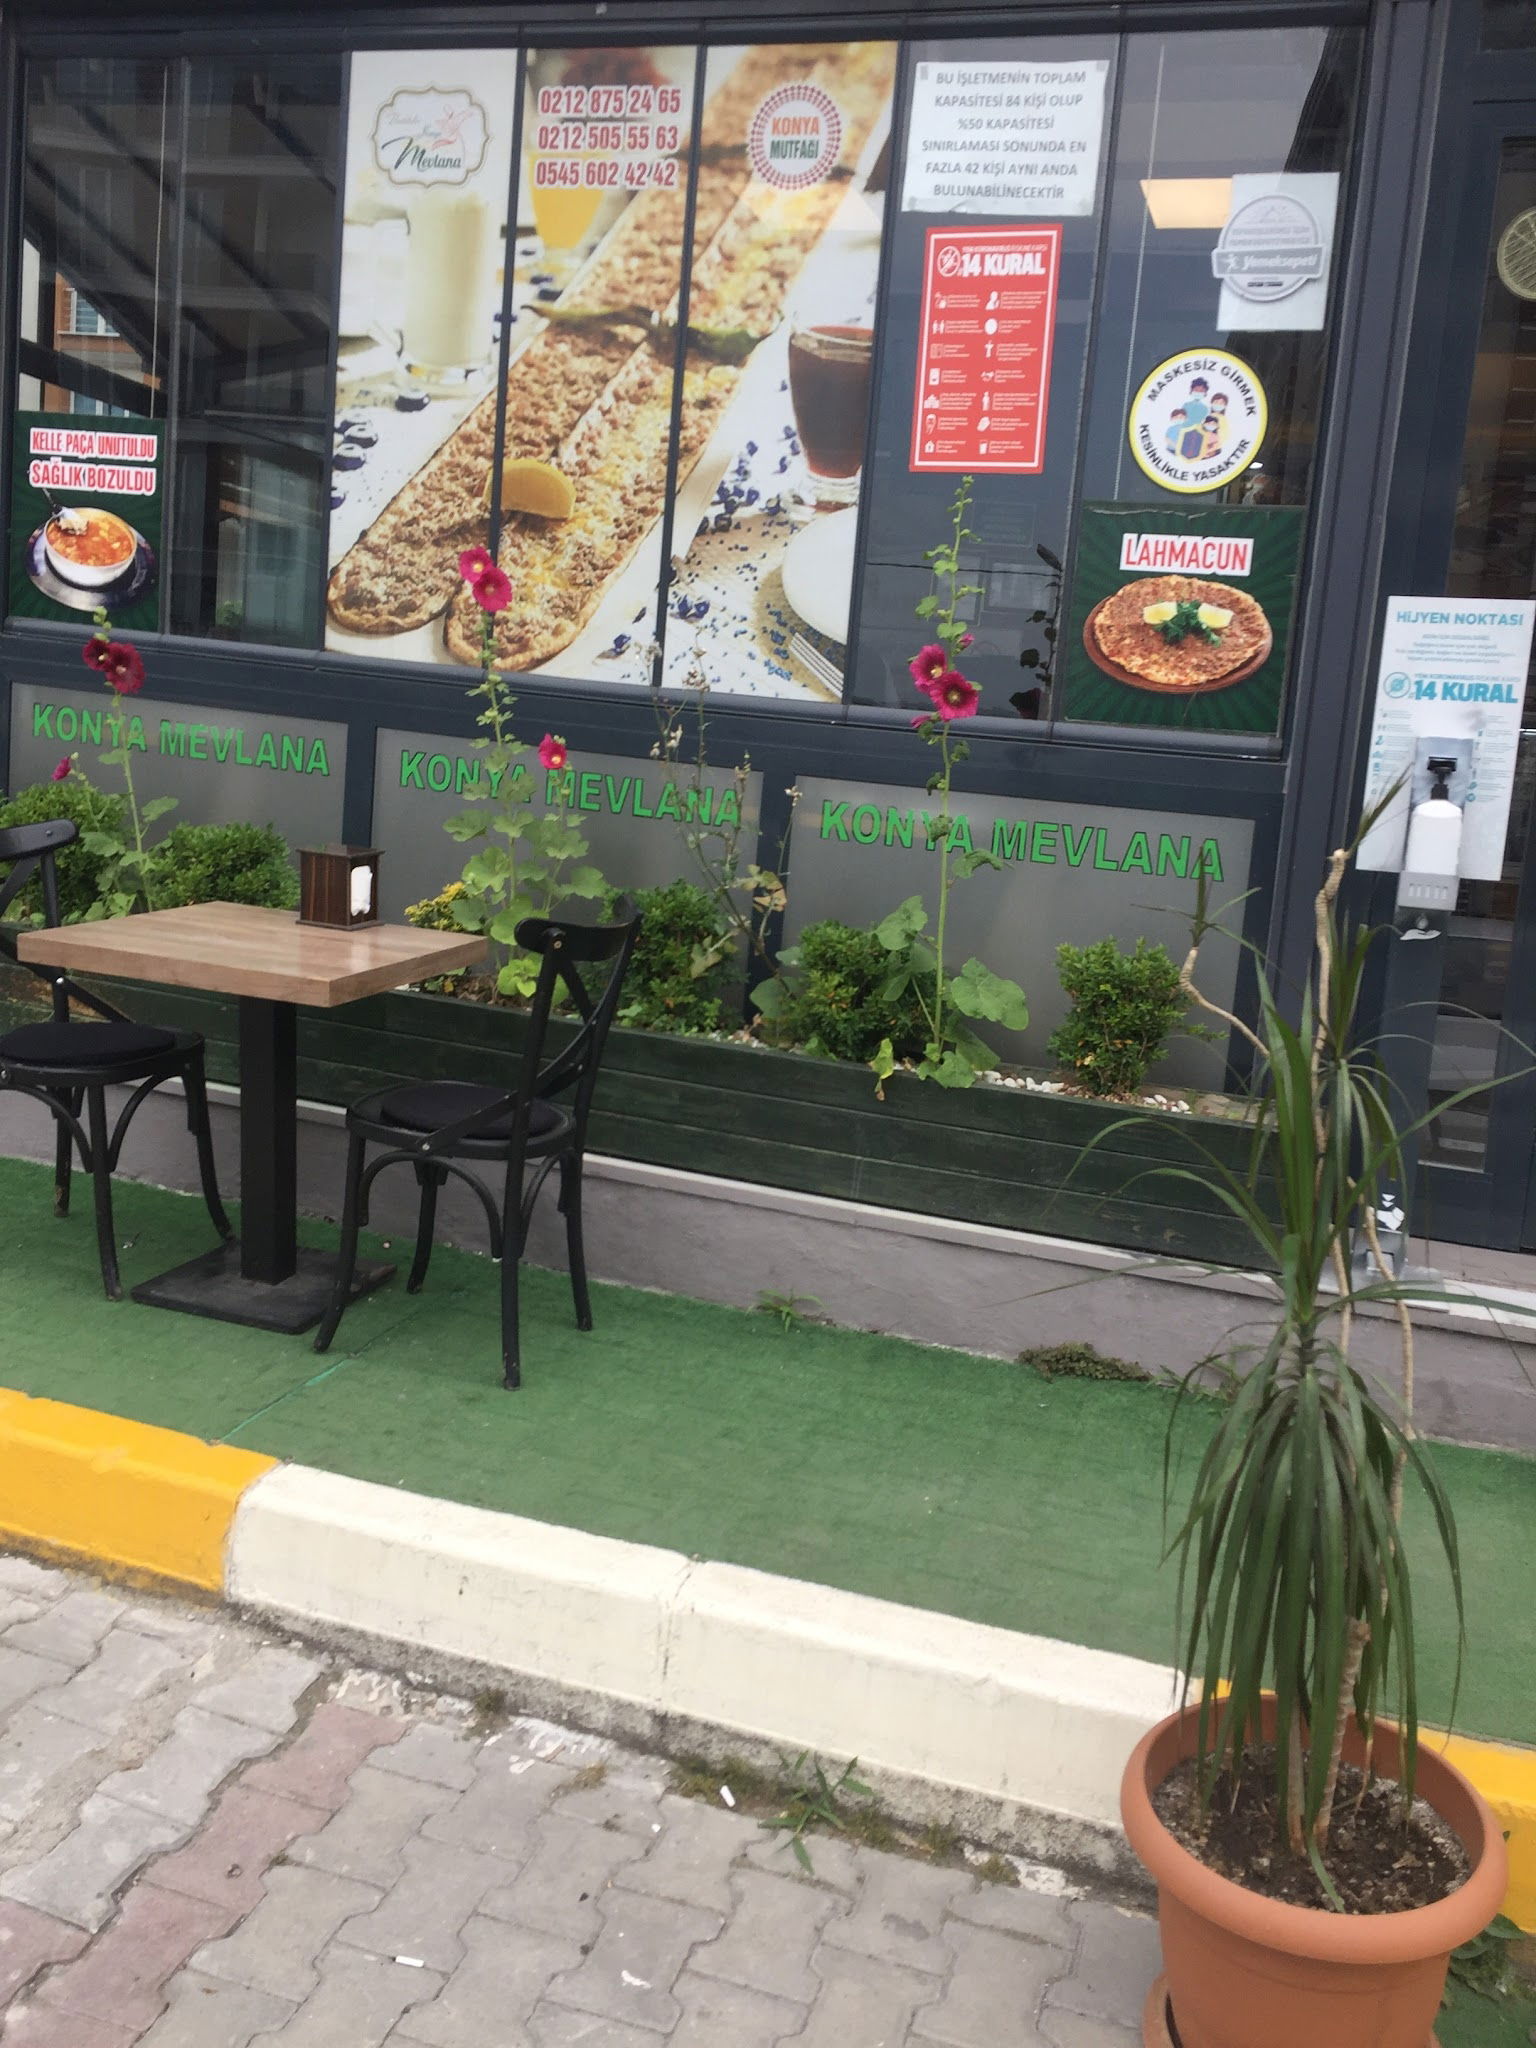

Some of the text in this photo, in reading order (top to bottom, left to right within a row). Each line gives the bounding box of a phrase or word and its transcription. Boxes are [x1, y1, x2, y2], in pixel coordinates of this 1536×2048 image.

[936, 70, 1086, 87] BU İŞLETMENİN TOPLAM
[540, 88, 681, 114] 0212 875 24 65
[935, 92, 1083, 109] KAPASİTESİ 84 KİŞİ OLUP
[772, 116, 819, 135] KONYA
[958, 116, 1054, 129] %50 KAPASİTESİ
[538, 125, 678, 150] 0212 505 55 63
[769, 140, 819, 159] MUTFAĞI
[922, 140, 1087, 153] SINIRLAMASI SONUNDA EN
[381, 136, 462, 172] Mevlana
[536, 162, 676, 187] 0545 602 42 42
[925, 161, 1078, 177] FAZLA 42 KİŞİ AYNI ANDA
[933, 183, 1065, 199] BULUNABİLİNECEKTİR
[961, 252, 1046, 277] 14 KURAL
[1147, 358, 1257, 417] MASKESİZ GİRMEK
[32, 431, 154, 458] KELLE PAÇA UNUTULDU
[1140, 423, 1251, 481] KESİNLİKLE YASAKTIR
[32, 461, 154, 492] SAĞLIK BOZULDU
[1125, 538, 1248, 571] LAHMACUN
[1396, 611, 1524, 626] HİJYEN NOKTASI
[1414, 679, 1518, 704] 14 KURAL
[33, 702, 330, 776] KONYA MEVLANA
[545, 766, 741, 828] MEVLANA
[990, 816, 1224, 883] MEVLANA
